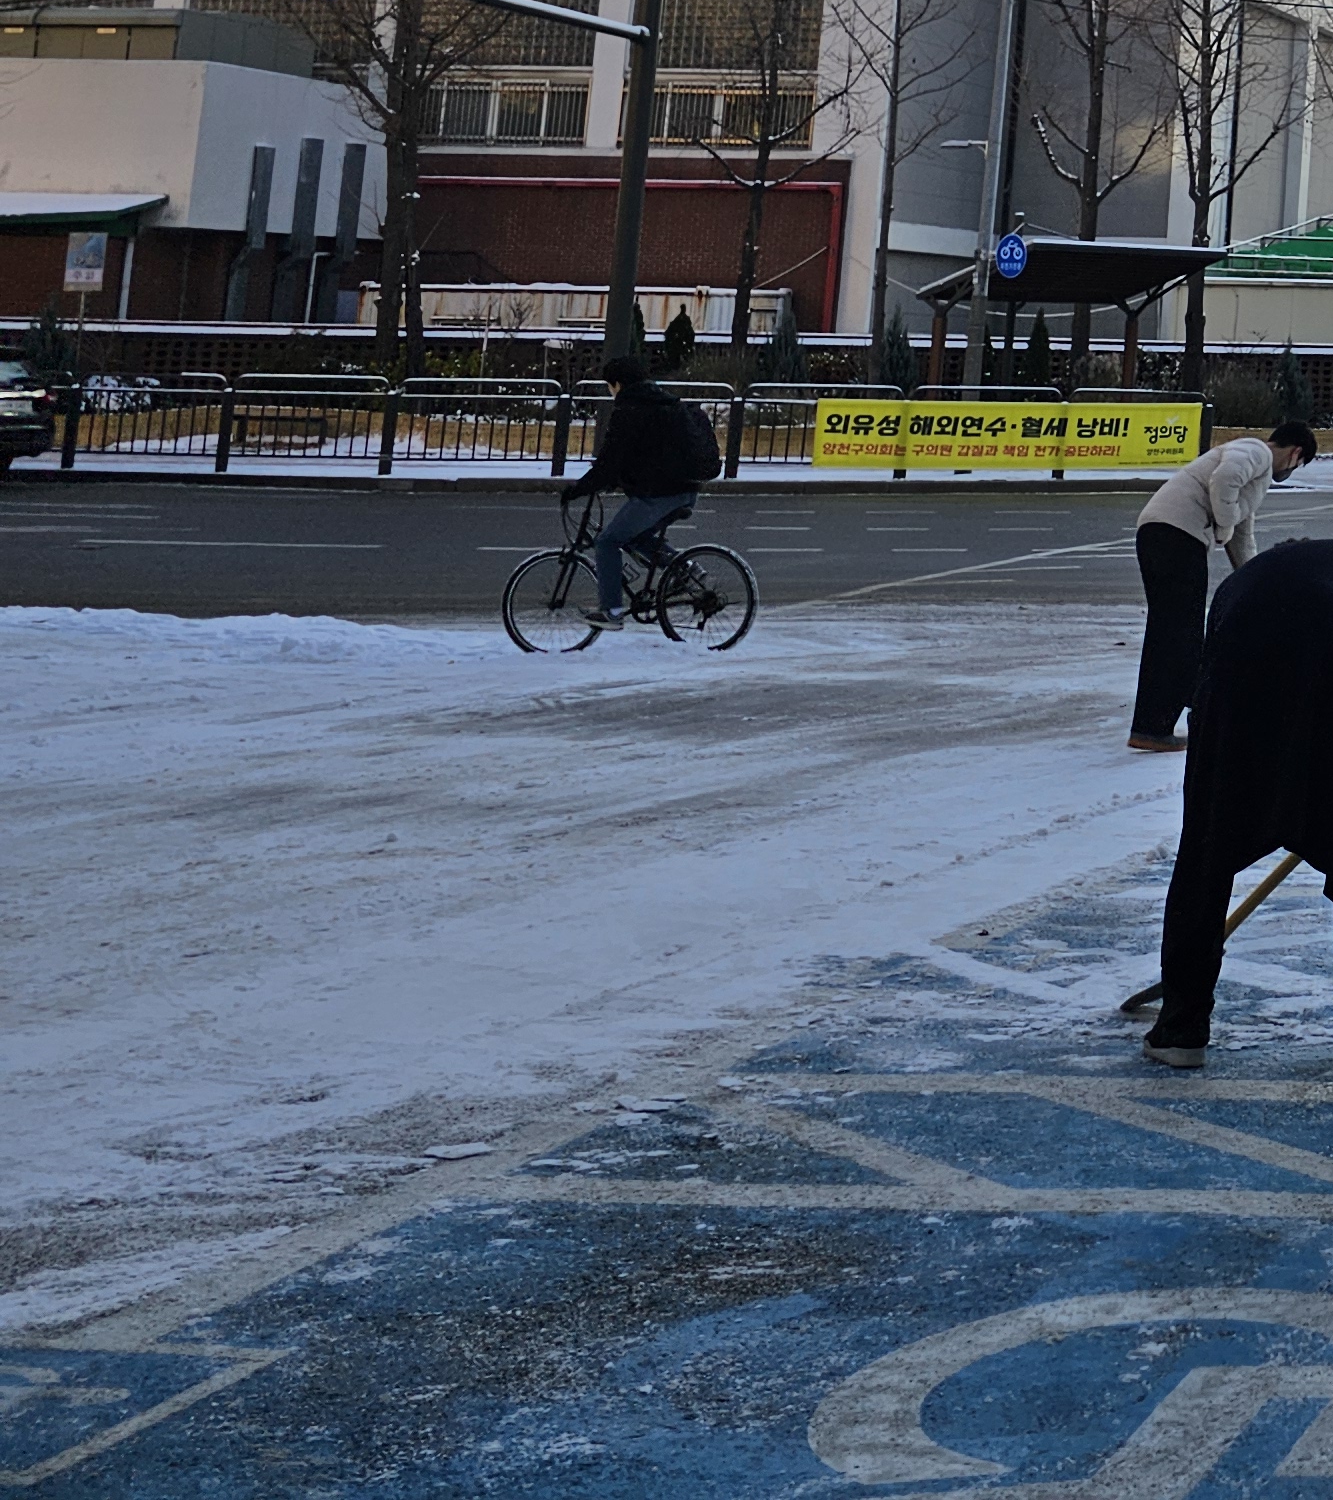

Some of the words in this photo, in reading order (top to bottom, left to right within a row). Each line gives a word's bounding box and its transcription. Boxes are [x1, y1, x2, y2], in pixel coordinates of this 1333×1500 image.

[824, 414, 901, 436] 외유성
[1077, 417, 1130, 438] 낭비!
[1144, 425, 1188, 444] 정의당
[822, 443, 907, 457] 양천구의회는
[912, 444, 953, 457] 구의원
[957, 445, 998, 457] 갑질과
[1002, 445, 1030, 457] 책임
[1034, 445, 1061, 457] 전가
[1064, 445, 1121, 457] 중단하라!
